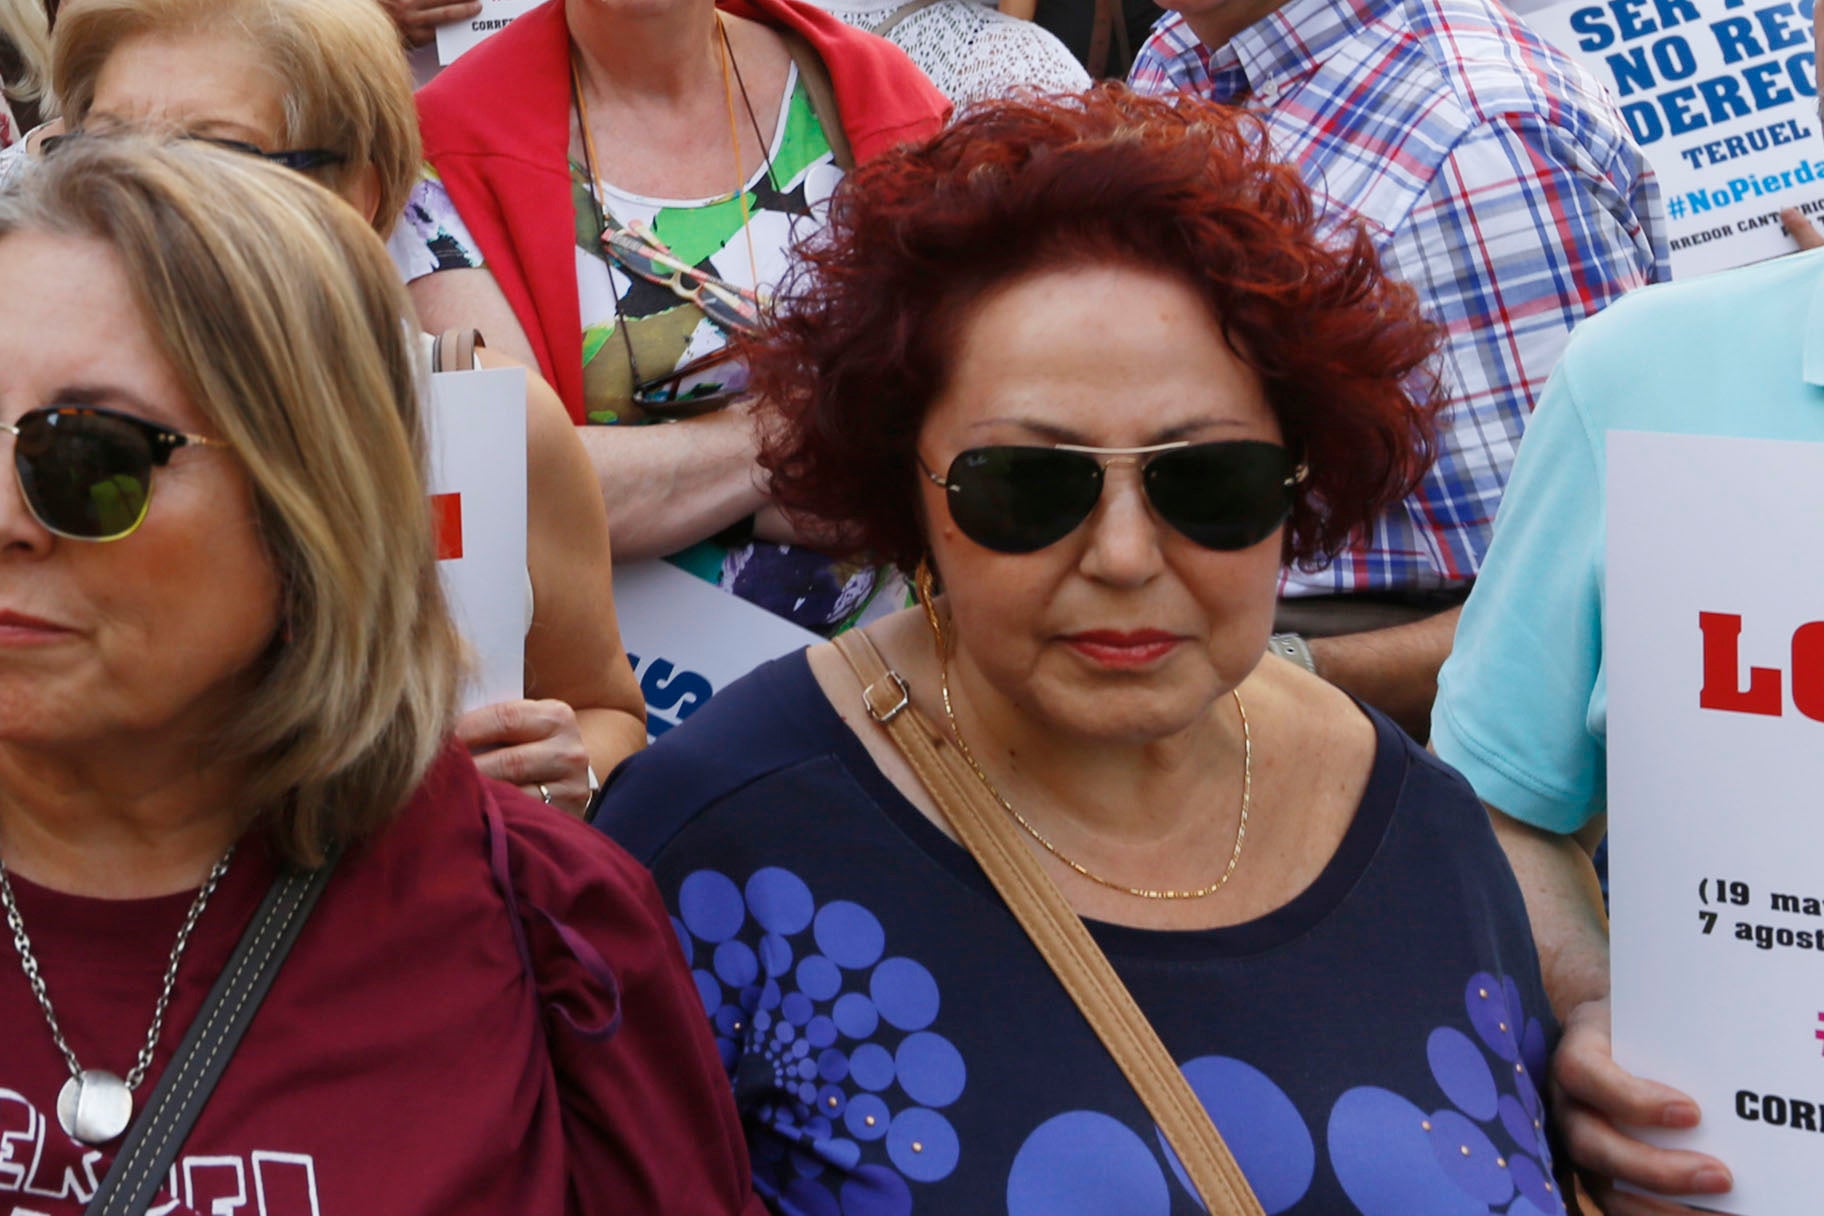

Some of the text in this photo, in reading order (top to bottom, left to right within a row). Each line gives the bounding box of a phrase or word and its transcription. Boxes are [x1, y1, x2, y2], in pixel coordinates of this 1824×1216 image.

[1606, 35, 1698, 97] NO
[1681, 119, 1812, 171] TERUEL
[1699, 878, 1824, 916] (19 ma
[1699, 910, 1718, 935] 7
[1736, 1089, 1824, 1133] COR
